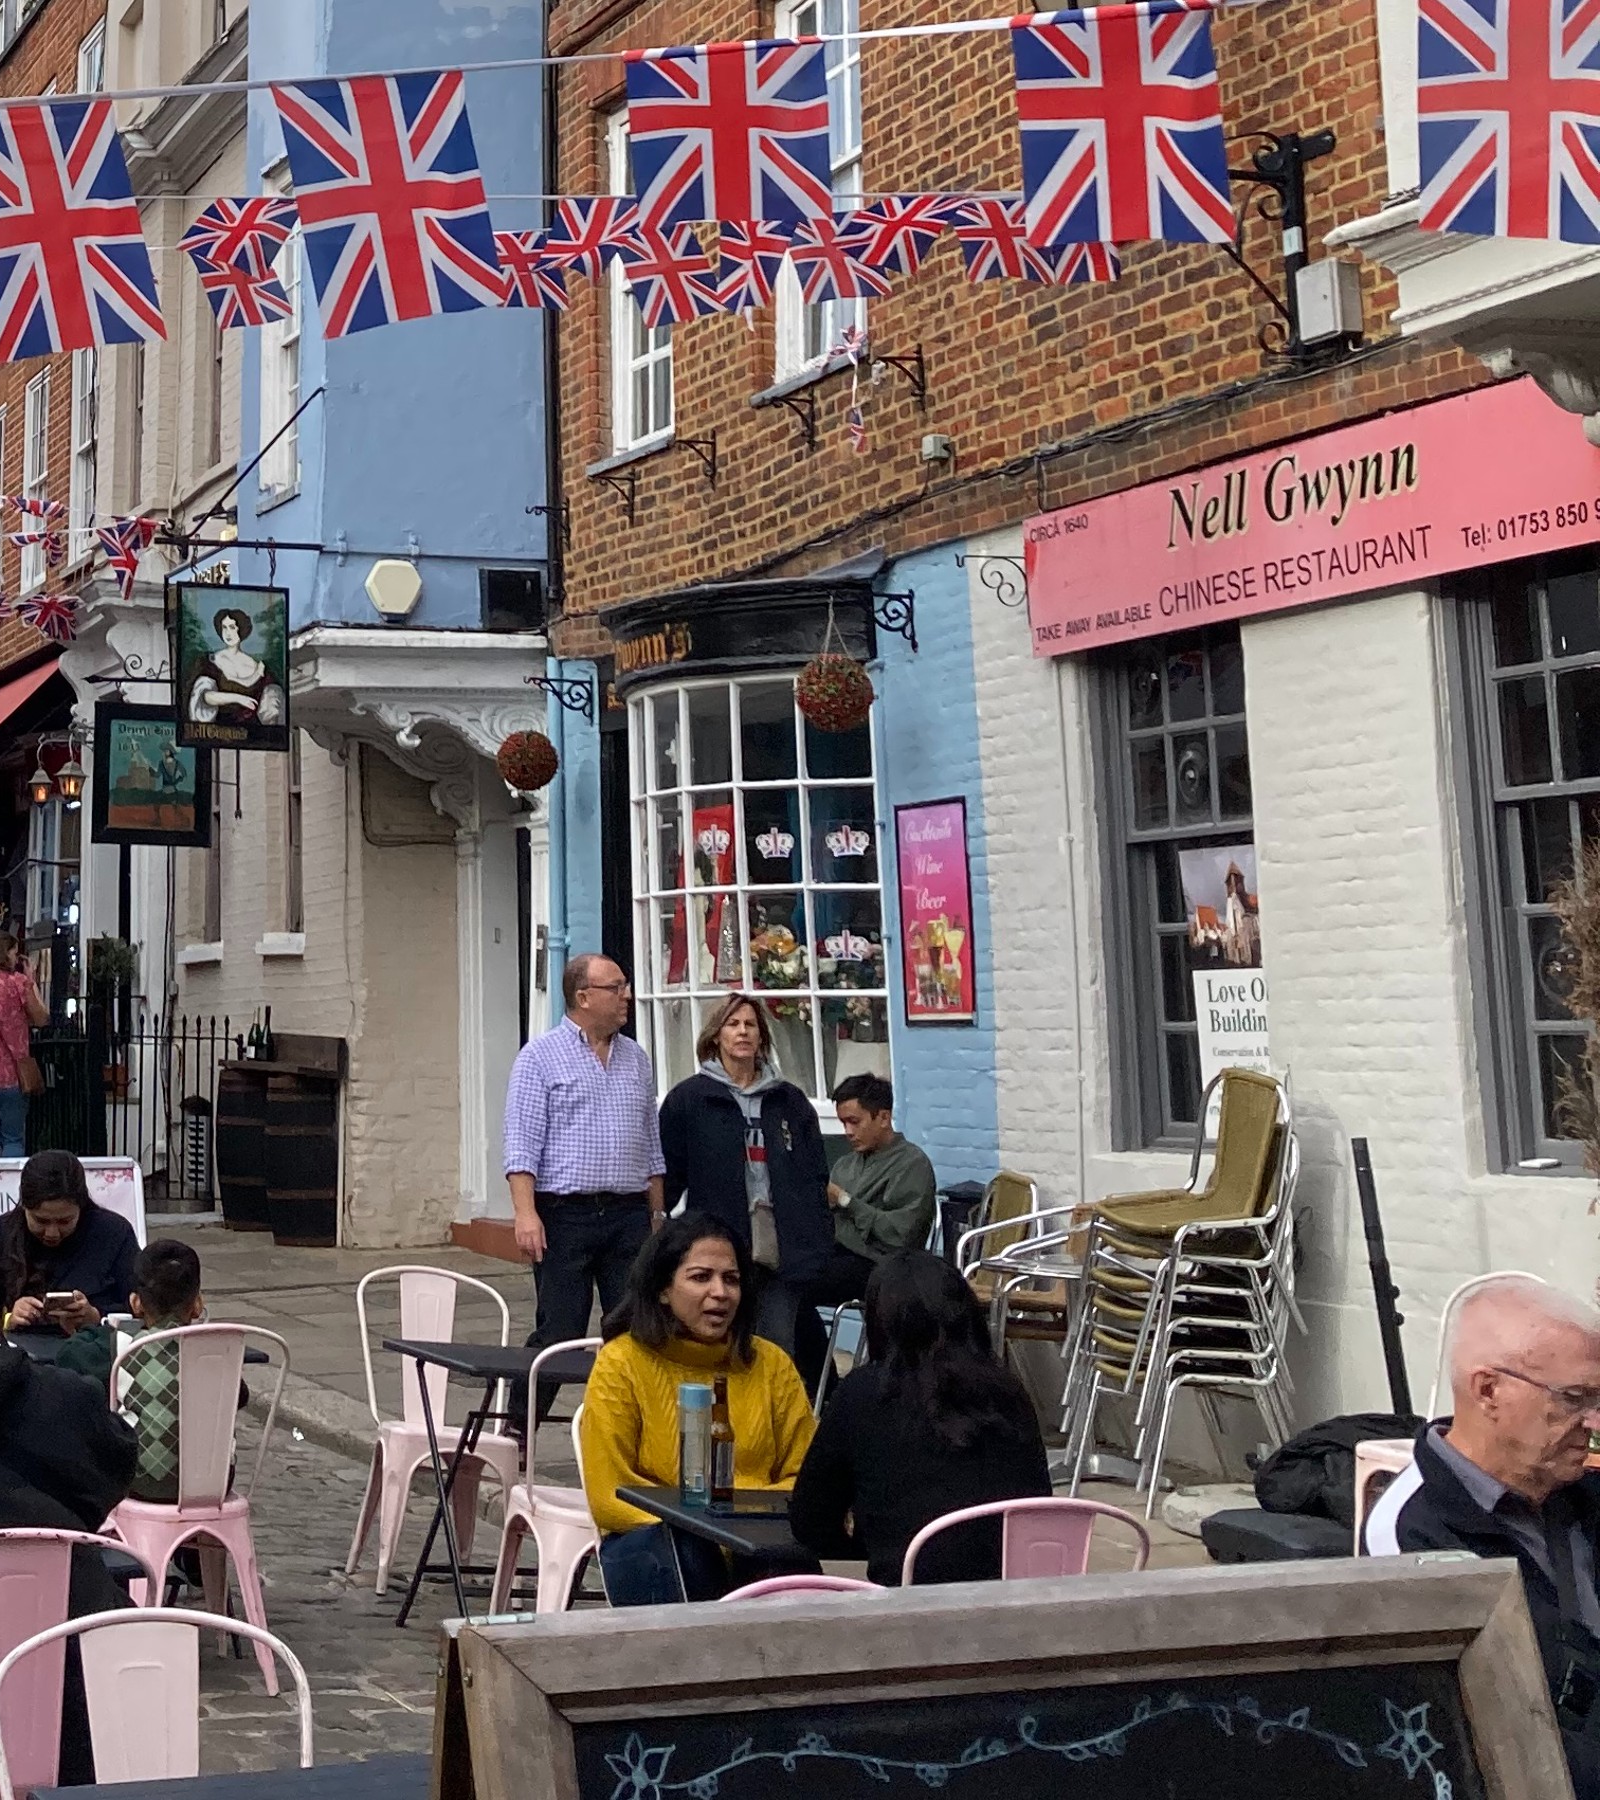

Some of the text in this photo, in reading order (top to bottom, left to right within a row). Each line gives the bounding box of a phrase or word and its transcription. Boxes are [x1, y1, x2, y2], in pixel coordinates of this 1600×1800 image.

[1166, 441, 1419, 549] Nell Gwynn
[1029, 513, 1089, 543] CIRCA 1640
[1461, 523, 1493, 549] Tel:
[1496, 510, 1550, 540] 01753
[1556, 501, 1588, 528] 850
[1158, 524, 1431, 616] CHINESE RESTAURANT
[1036, 602, 1152, 642] TAKE AWAY AVAILABLE
[1206, 979, 1247, 1003] Love
[1209, 1008, 1268, 1033] Buildin
